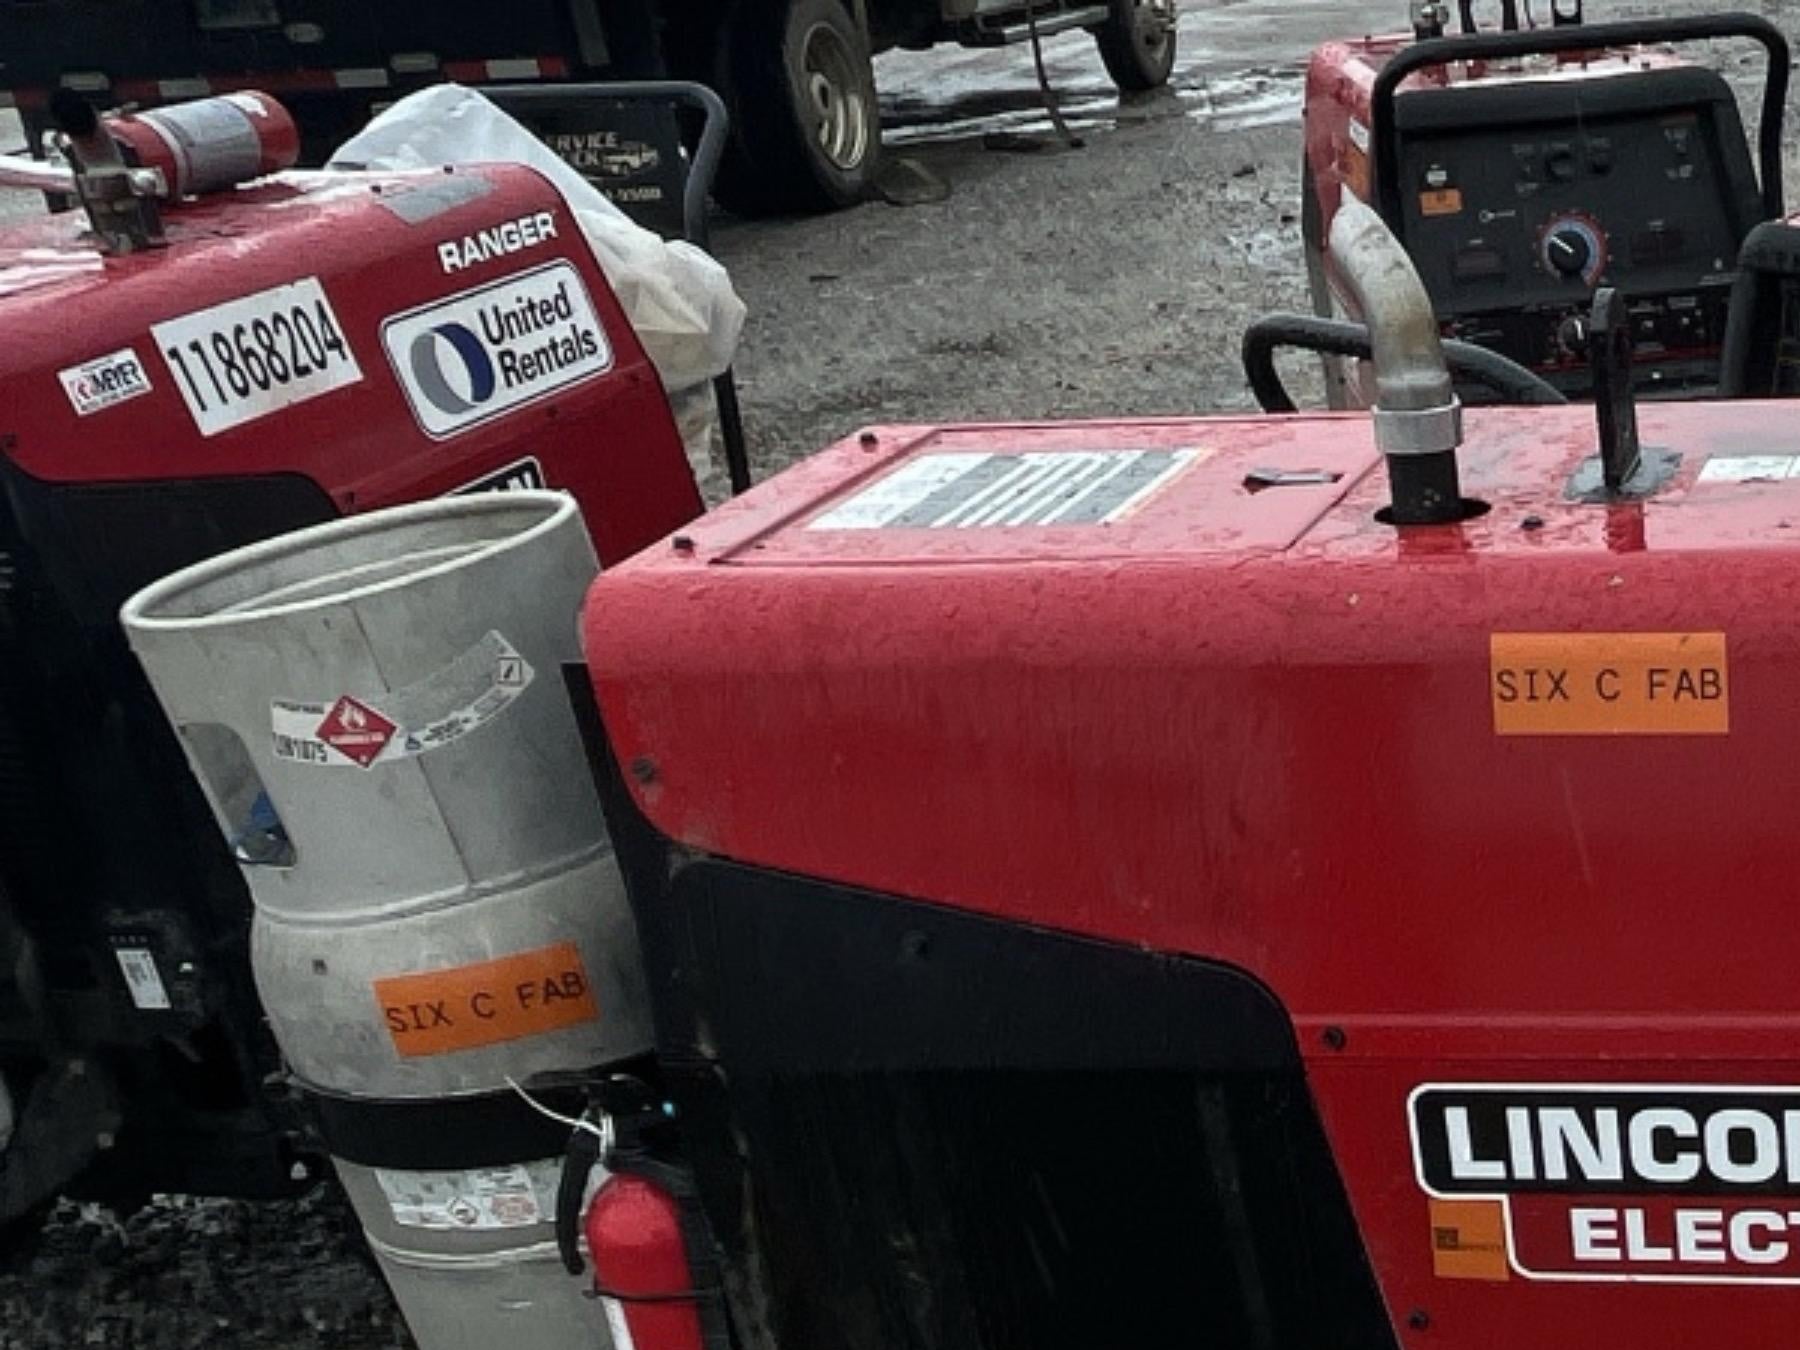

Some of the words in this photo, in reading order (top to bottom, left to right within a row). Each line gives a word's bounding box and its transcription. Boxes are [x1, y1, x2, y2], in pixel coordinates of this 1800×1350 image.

[437, 212, 558, 274] RANGER
[478, 280, 572, 347] United
[167, 299, 348, 412] 11868204
[497, 323, 599, 388] Rentals
[1496, 668, 1570, 702] SIX
[1595, 668, 1622, 702] C
[1647, 667, 1722, 702] FAB
[386, 1000, 453, 1033] SIX
[470, 992, 496, 1019] C
[516, 971, 586, 1009] FAB
